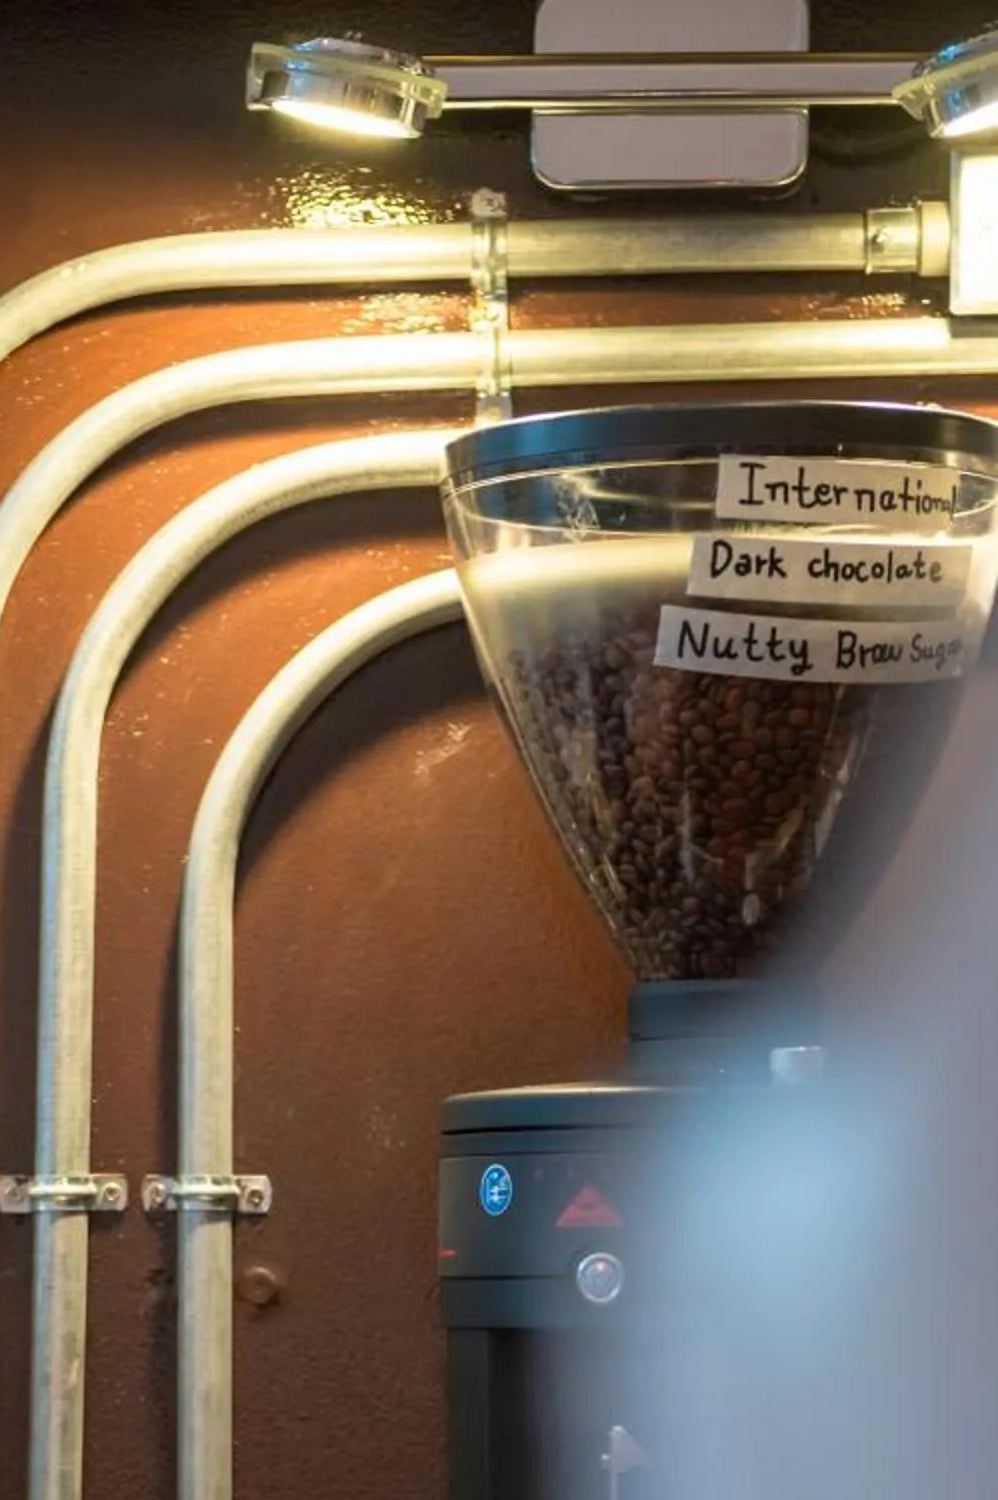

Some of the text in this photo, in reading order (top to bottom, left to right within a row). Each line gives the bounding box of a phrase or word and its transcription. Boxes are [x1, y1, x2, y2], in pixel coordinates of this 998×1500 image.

[710, 539, 946, 583] Dark chocolate
[678, 619, 815, 677] Nutty
